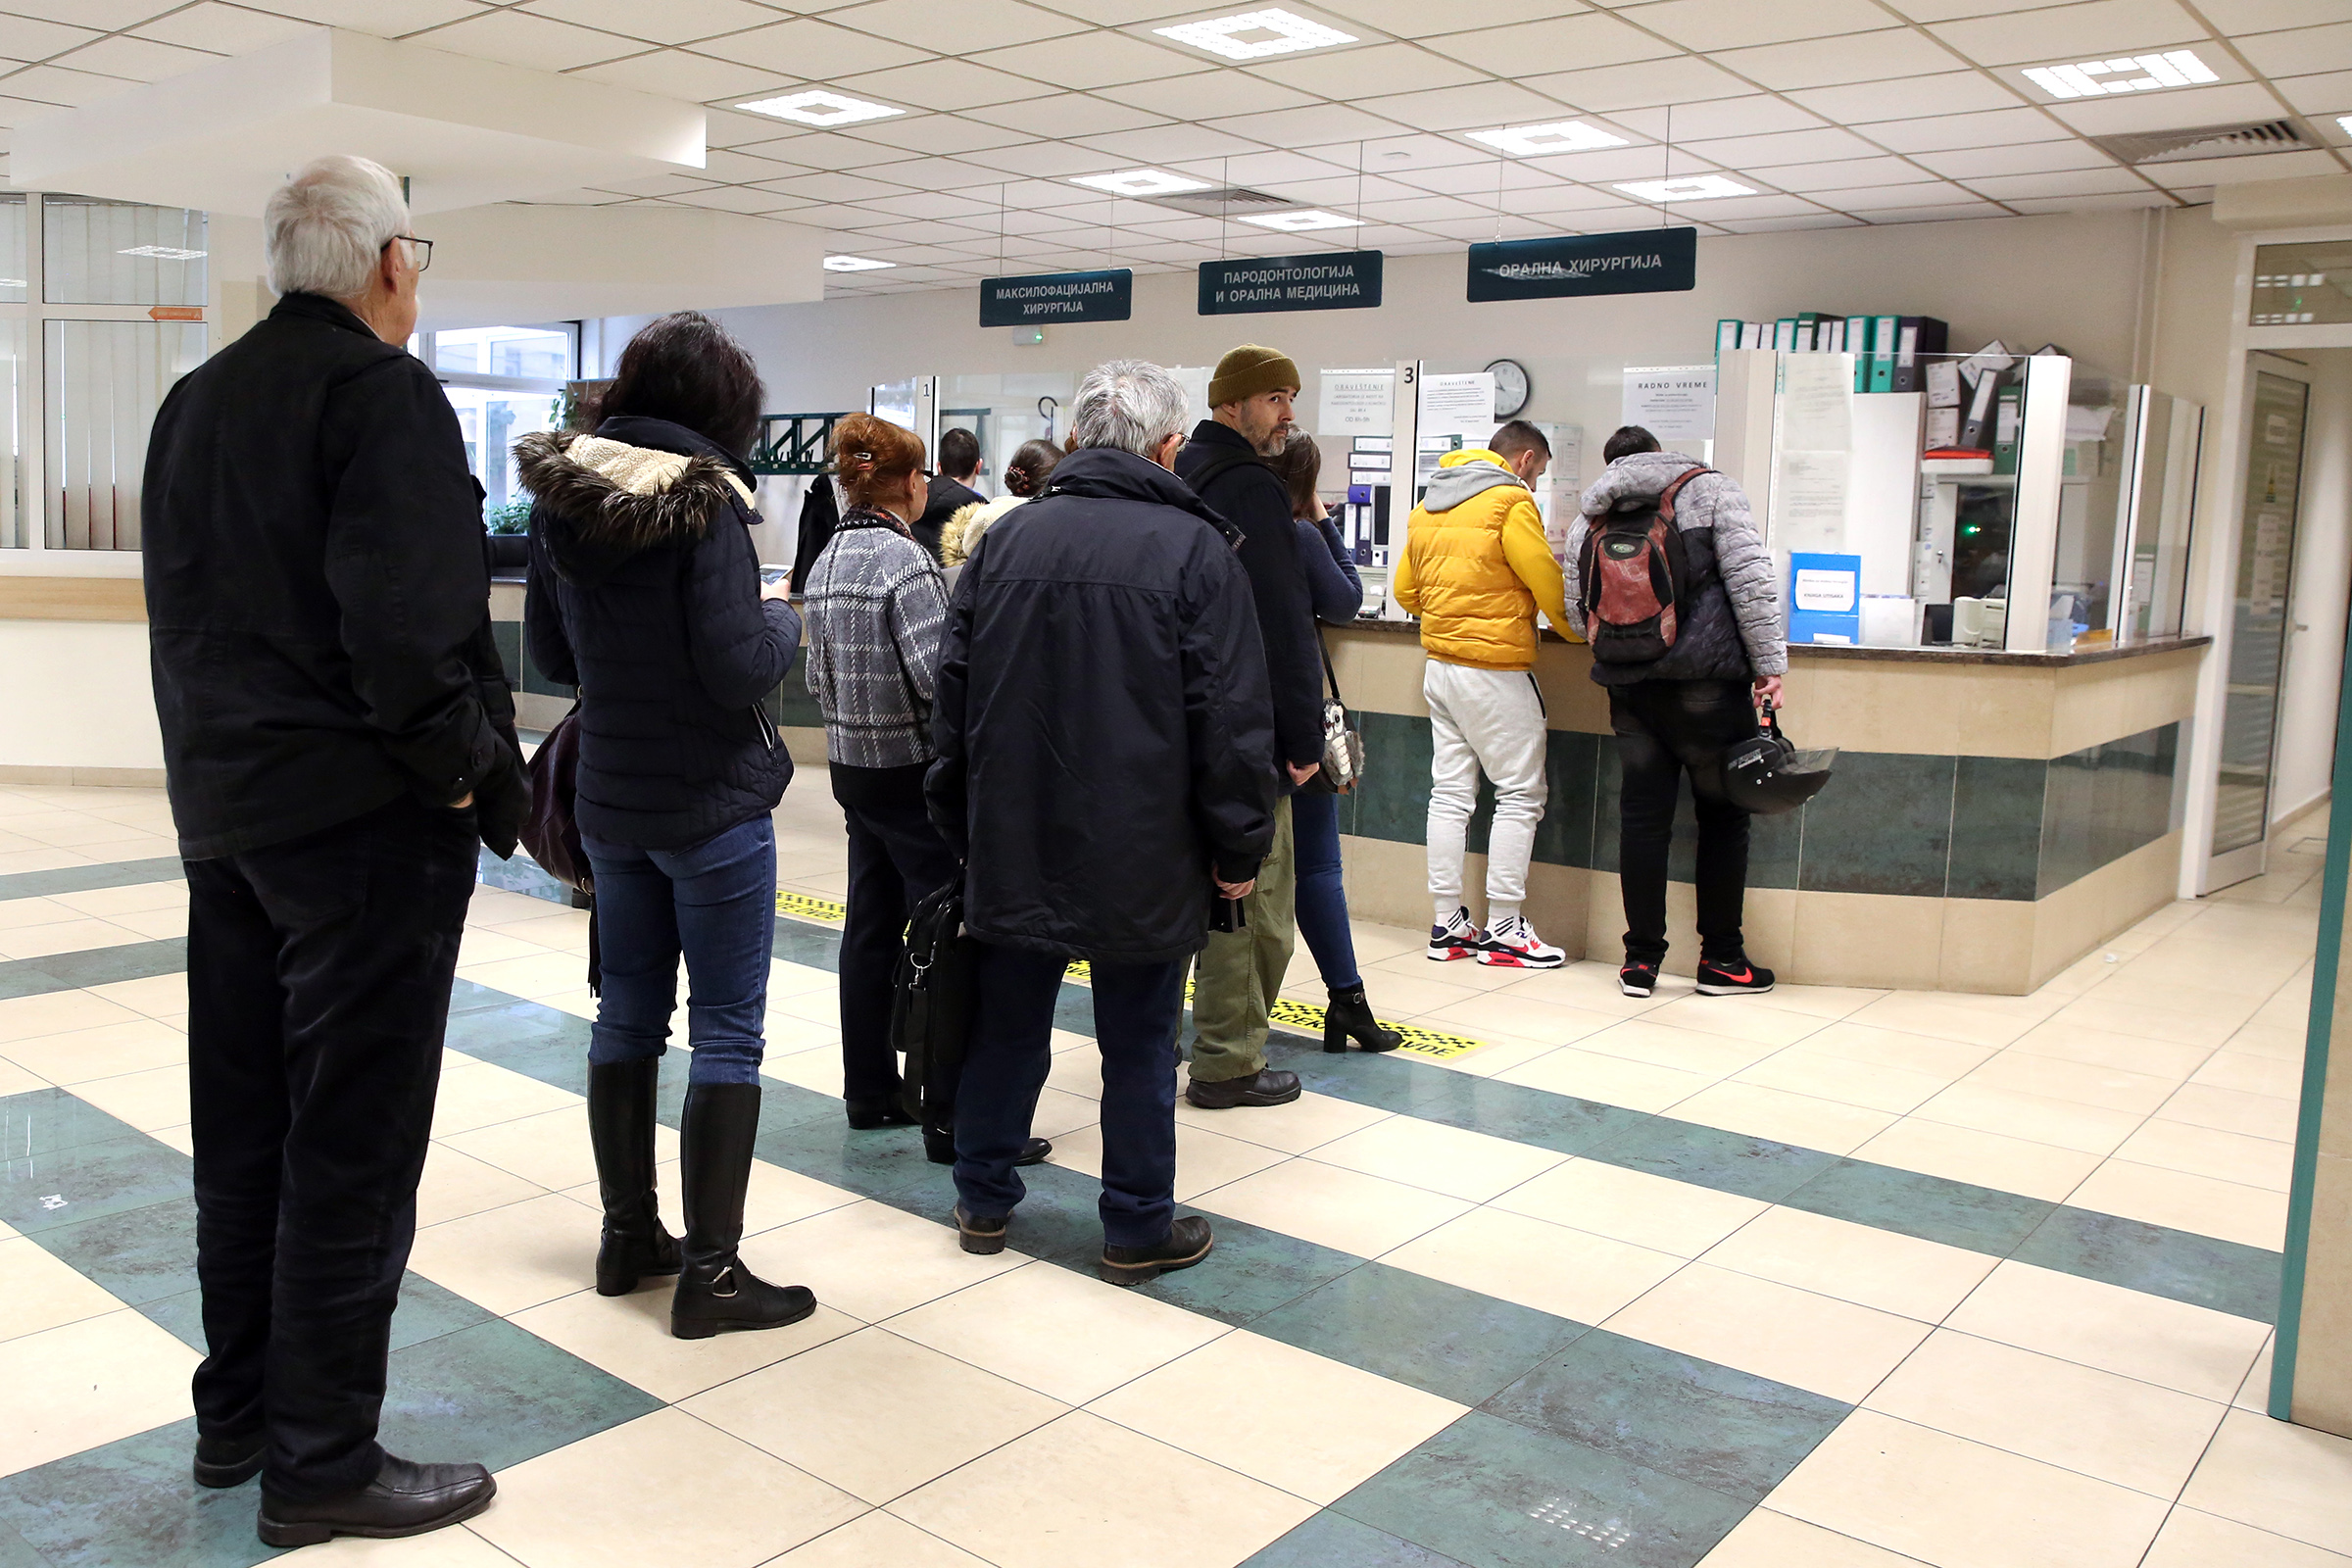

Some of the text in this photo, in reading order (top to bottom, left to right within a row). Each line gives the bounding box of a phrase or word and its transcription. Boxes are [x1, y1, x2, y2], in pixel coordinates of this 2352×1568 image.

[1224, 265, 1354, 285] ПАРОДОНТОЛОГИЈА
[1498, 254, 1662, 277] ОРАЛНА ХИРУРГИЈА
[996, 281, 1113, 300] МАКСИЛОФАЦИЈАЛНА
[1215, 283, 1360, 303] И ОРАЛНА МЕДИЦИНА
[1023, 301, 1084, 316] ХИРУРГИЈА
[1403, 367, 1414, 384] 3
[923, 383, 930, 397] 1
